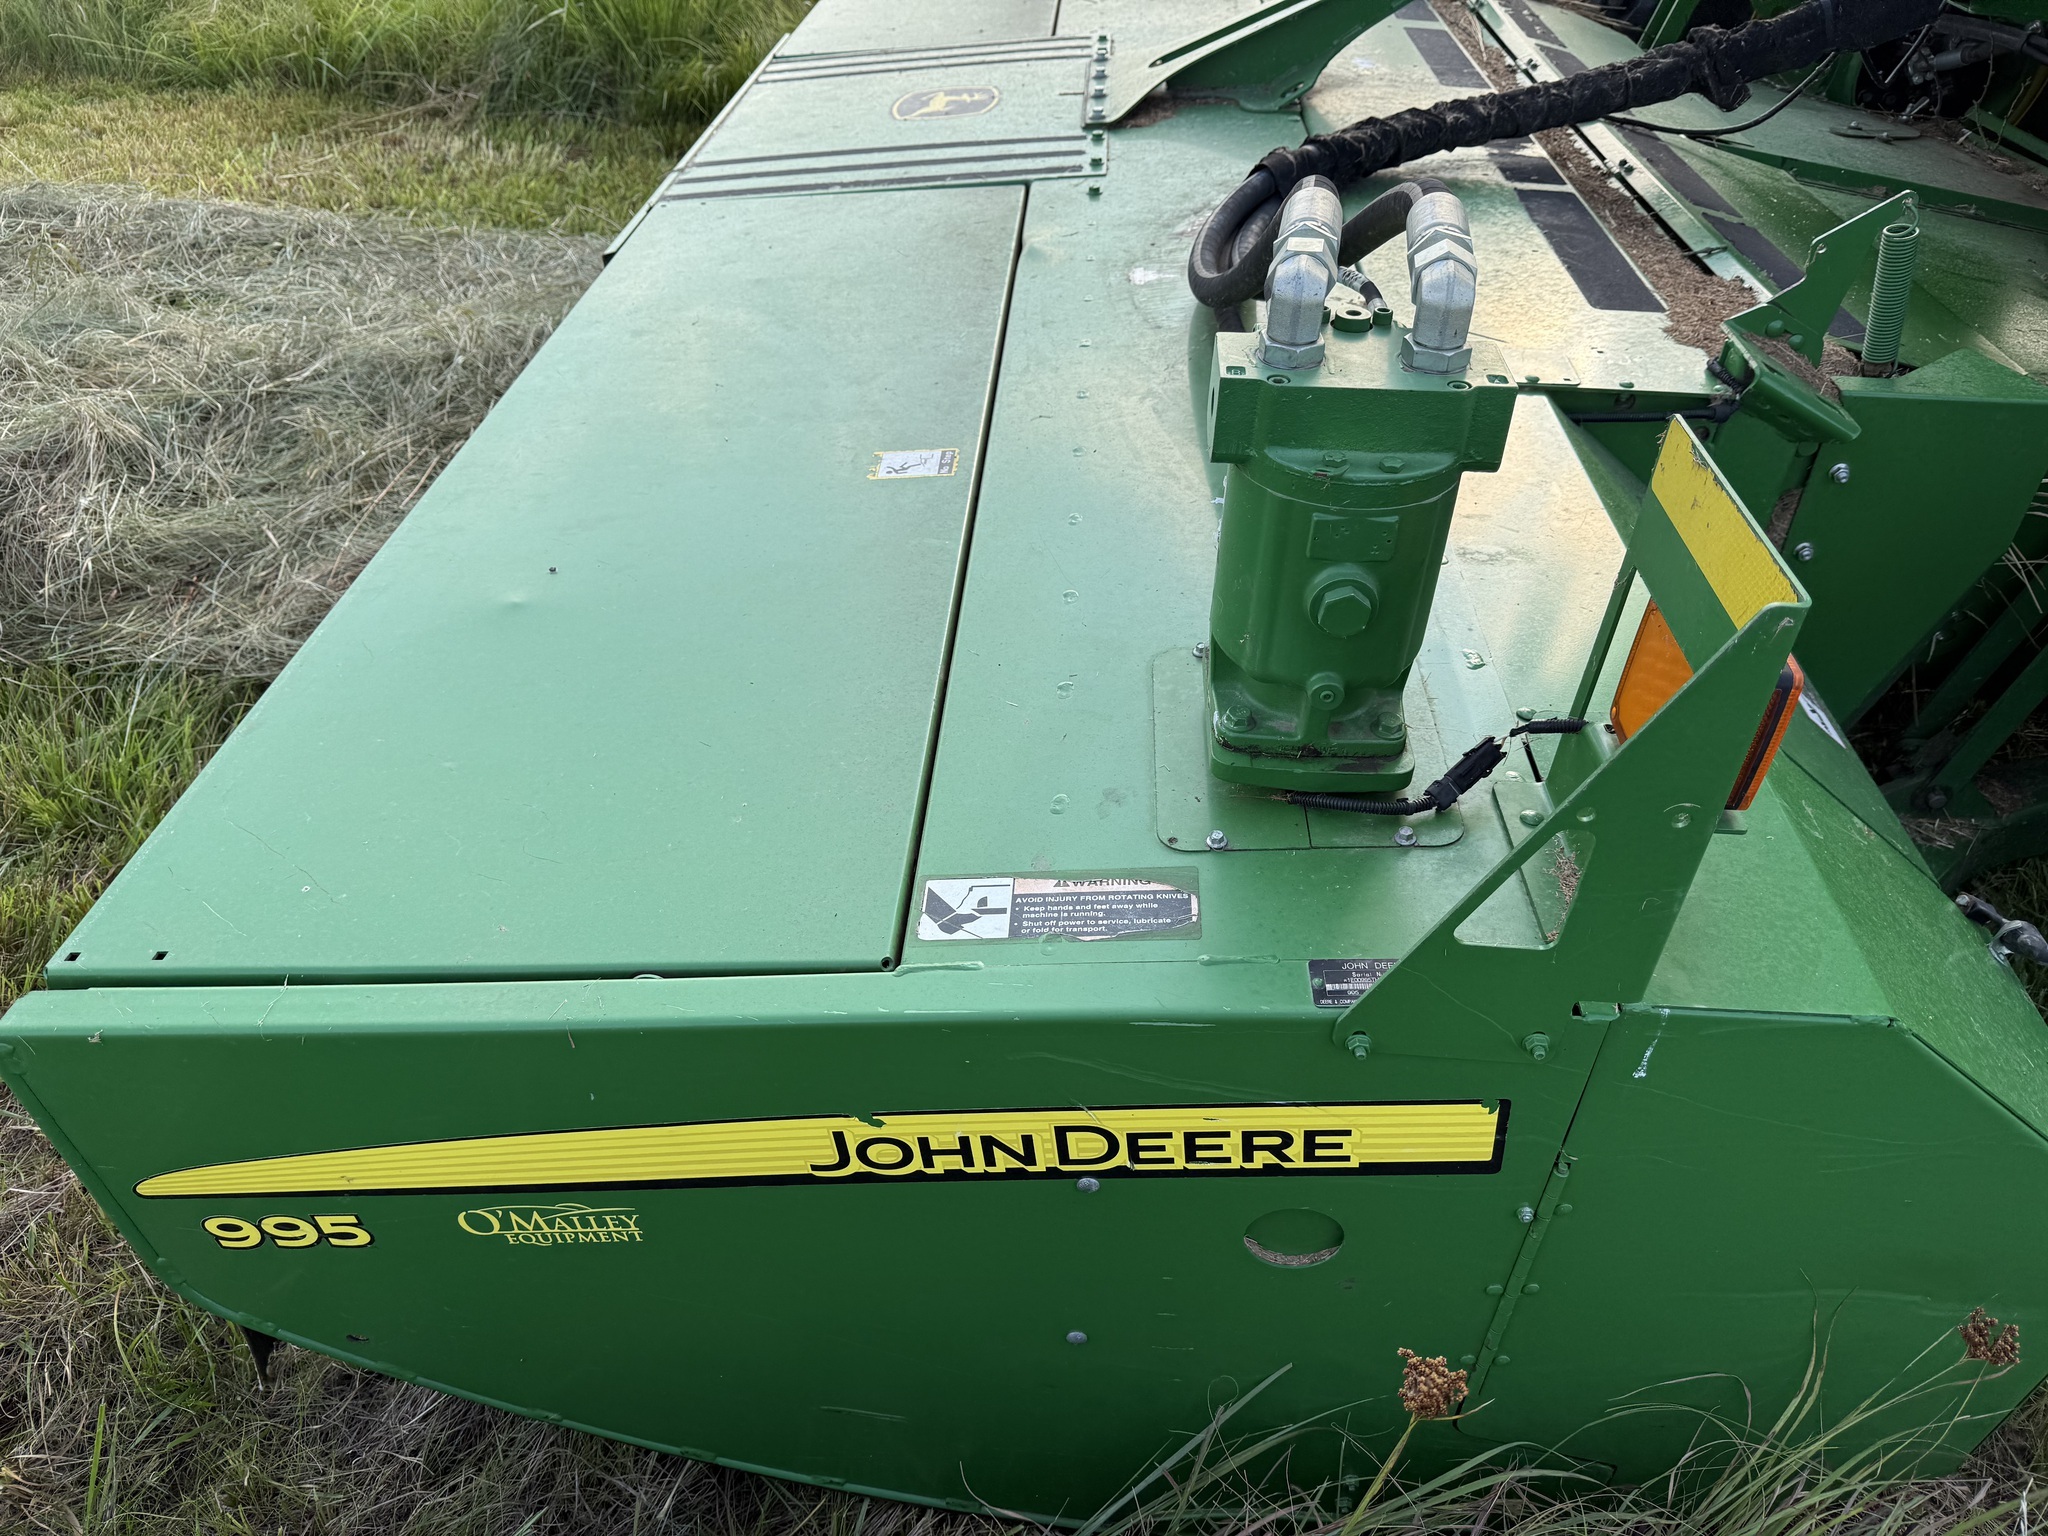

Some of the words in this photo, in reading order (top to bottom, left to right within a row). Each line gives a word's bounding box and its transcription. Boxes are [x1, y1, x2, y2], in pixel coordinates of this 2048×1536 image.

[1341, 962, 1369, 970] JOHN
[1374, 962, 1396, 970] DEE
[811, 1127, 1036, 1174] JOHN
[1052, 1124, 1354, 1169] DEERE
[202, 1214, 374, 1249] 995
[504, 1230, 644, 1246] EQUIPMENT
